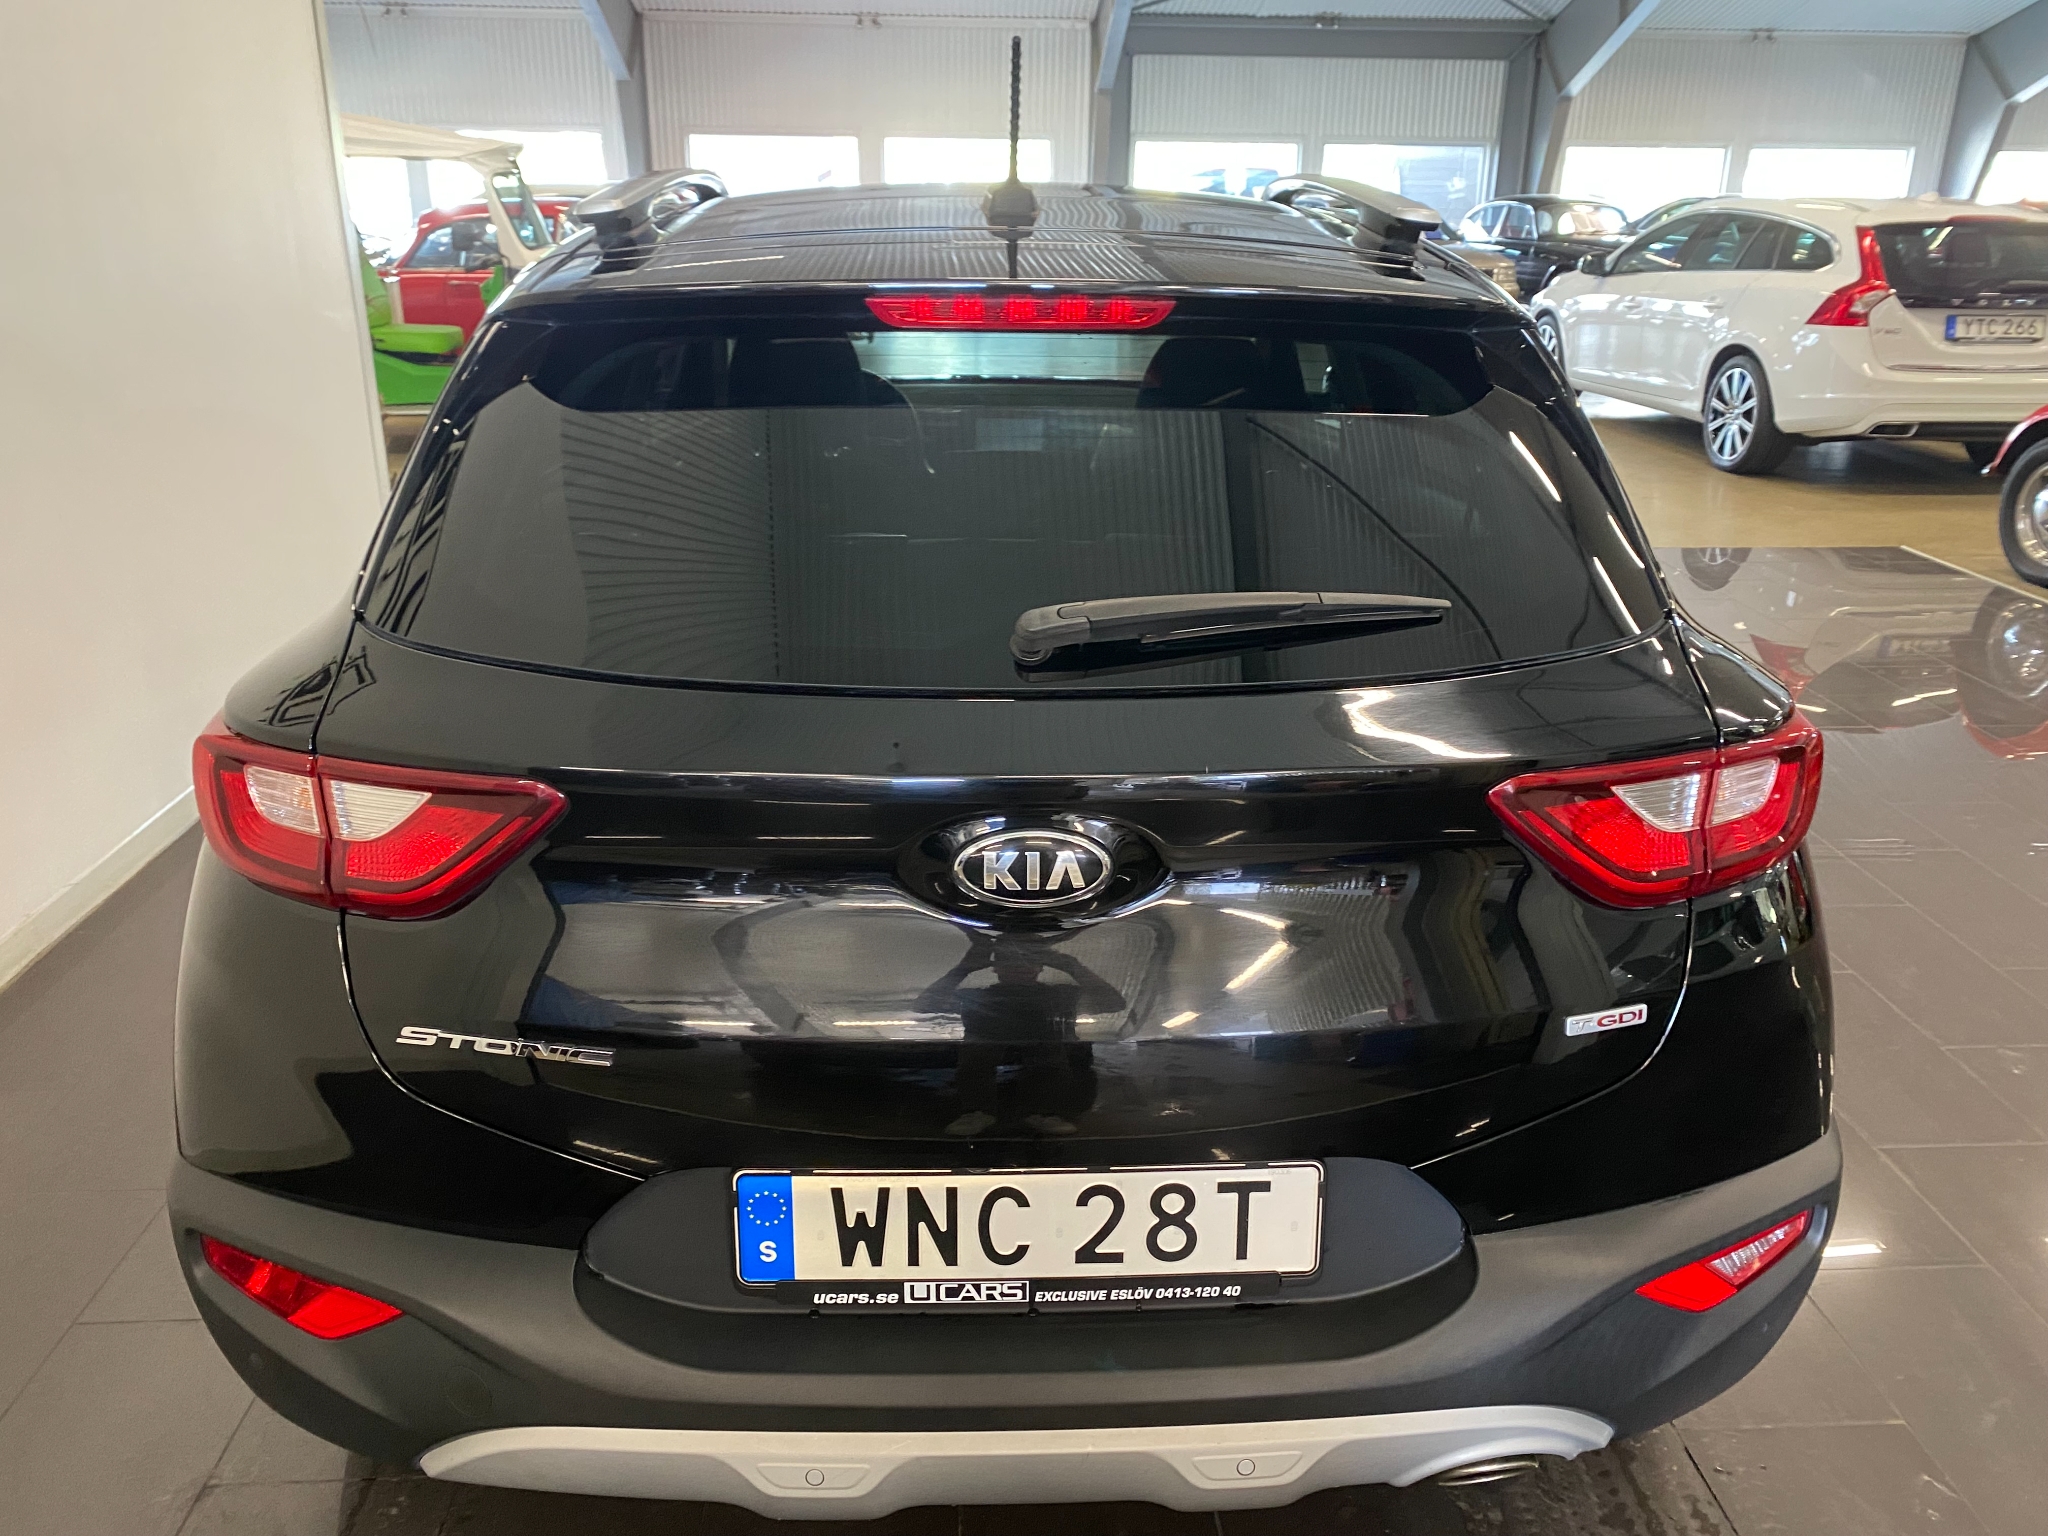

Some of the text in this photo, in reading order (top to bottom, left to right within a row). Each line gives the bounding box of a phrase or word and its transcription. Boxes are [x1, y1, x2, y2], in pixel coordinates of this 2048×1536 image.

[1963, 318, 1997, 335] YTC
[2003, 318, 2038, 335] 266
[981, 850, 1086, 891] KIA
[396, 1026, 615, 1067] STONIC
[830, 1180, 1272, 1268] WNC 28T
[758, 1240, 778, 1263] S
[813, 1292, 899, 1305] ucars.se
[1035, 1289, 1107, 1302] EXCLUSIVE
[1110, 1286, 1153, 1301] ESLÖV
[1155, 1286, 1220, 1299] 0413-120
[1223, 1285, 1241, 1297] 40
